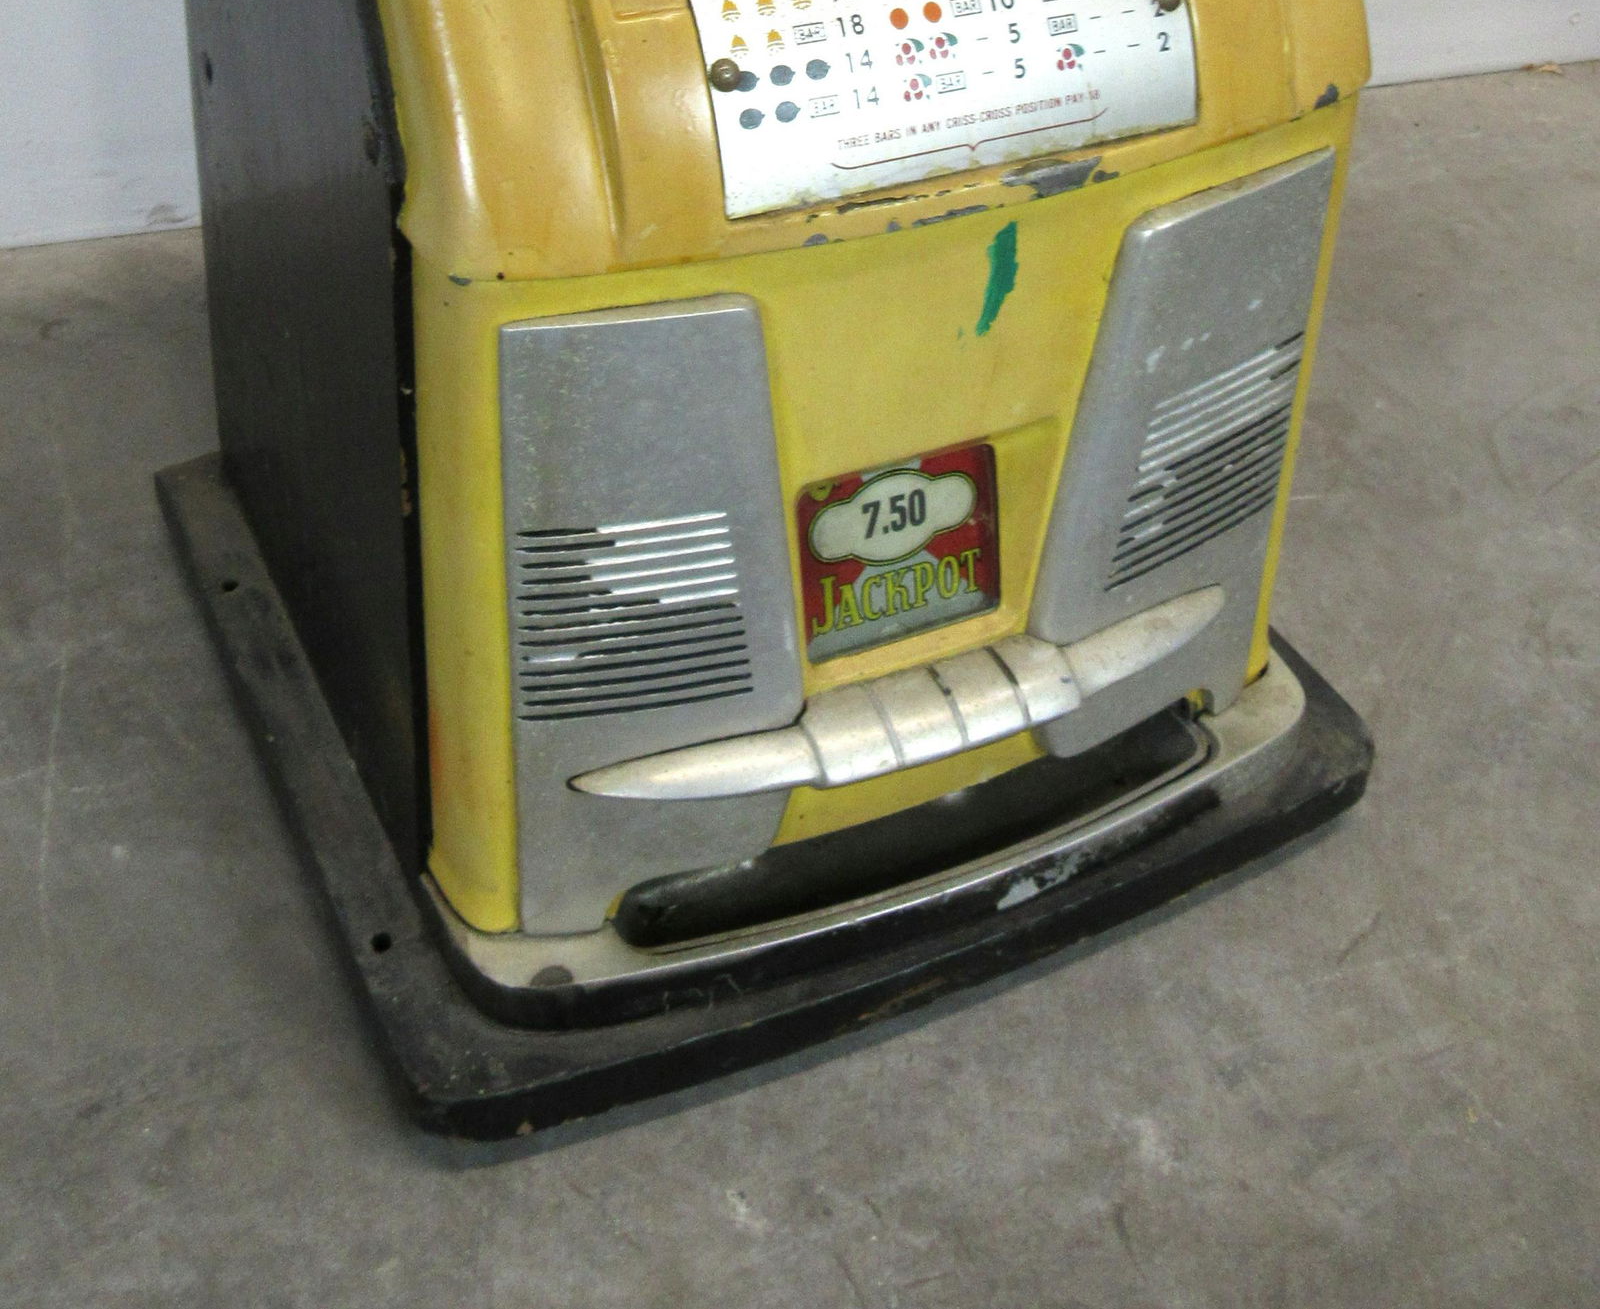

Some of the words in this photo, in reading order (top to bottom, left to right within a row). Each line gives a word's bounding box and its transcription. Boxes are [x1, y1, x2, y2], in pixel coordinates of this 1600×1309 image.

[954, 0, 977, 14] BAR
[836, 14, 865, 38] 18
[1008, 22, 1021, 44] 5
[1051, 17, 1074, 33] BAR
[1157, 31, 1170, 52] 2
[845, 49, 873, 73] 14
[1014, 57, 1026, 79] 5
[853, 86, 879, 110] 14
[874, 128, 902, 144] BARS
[921, 120, 941, 134] ANY
[1015, 97, 1062, 115] POSITION
[1064, 92, 1084, 106] PAY
[861, 488, 927, 540] 7.50
[811, 548, 983, 636] JACKPOT
